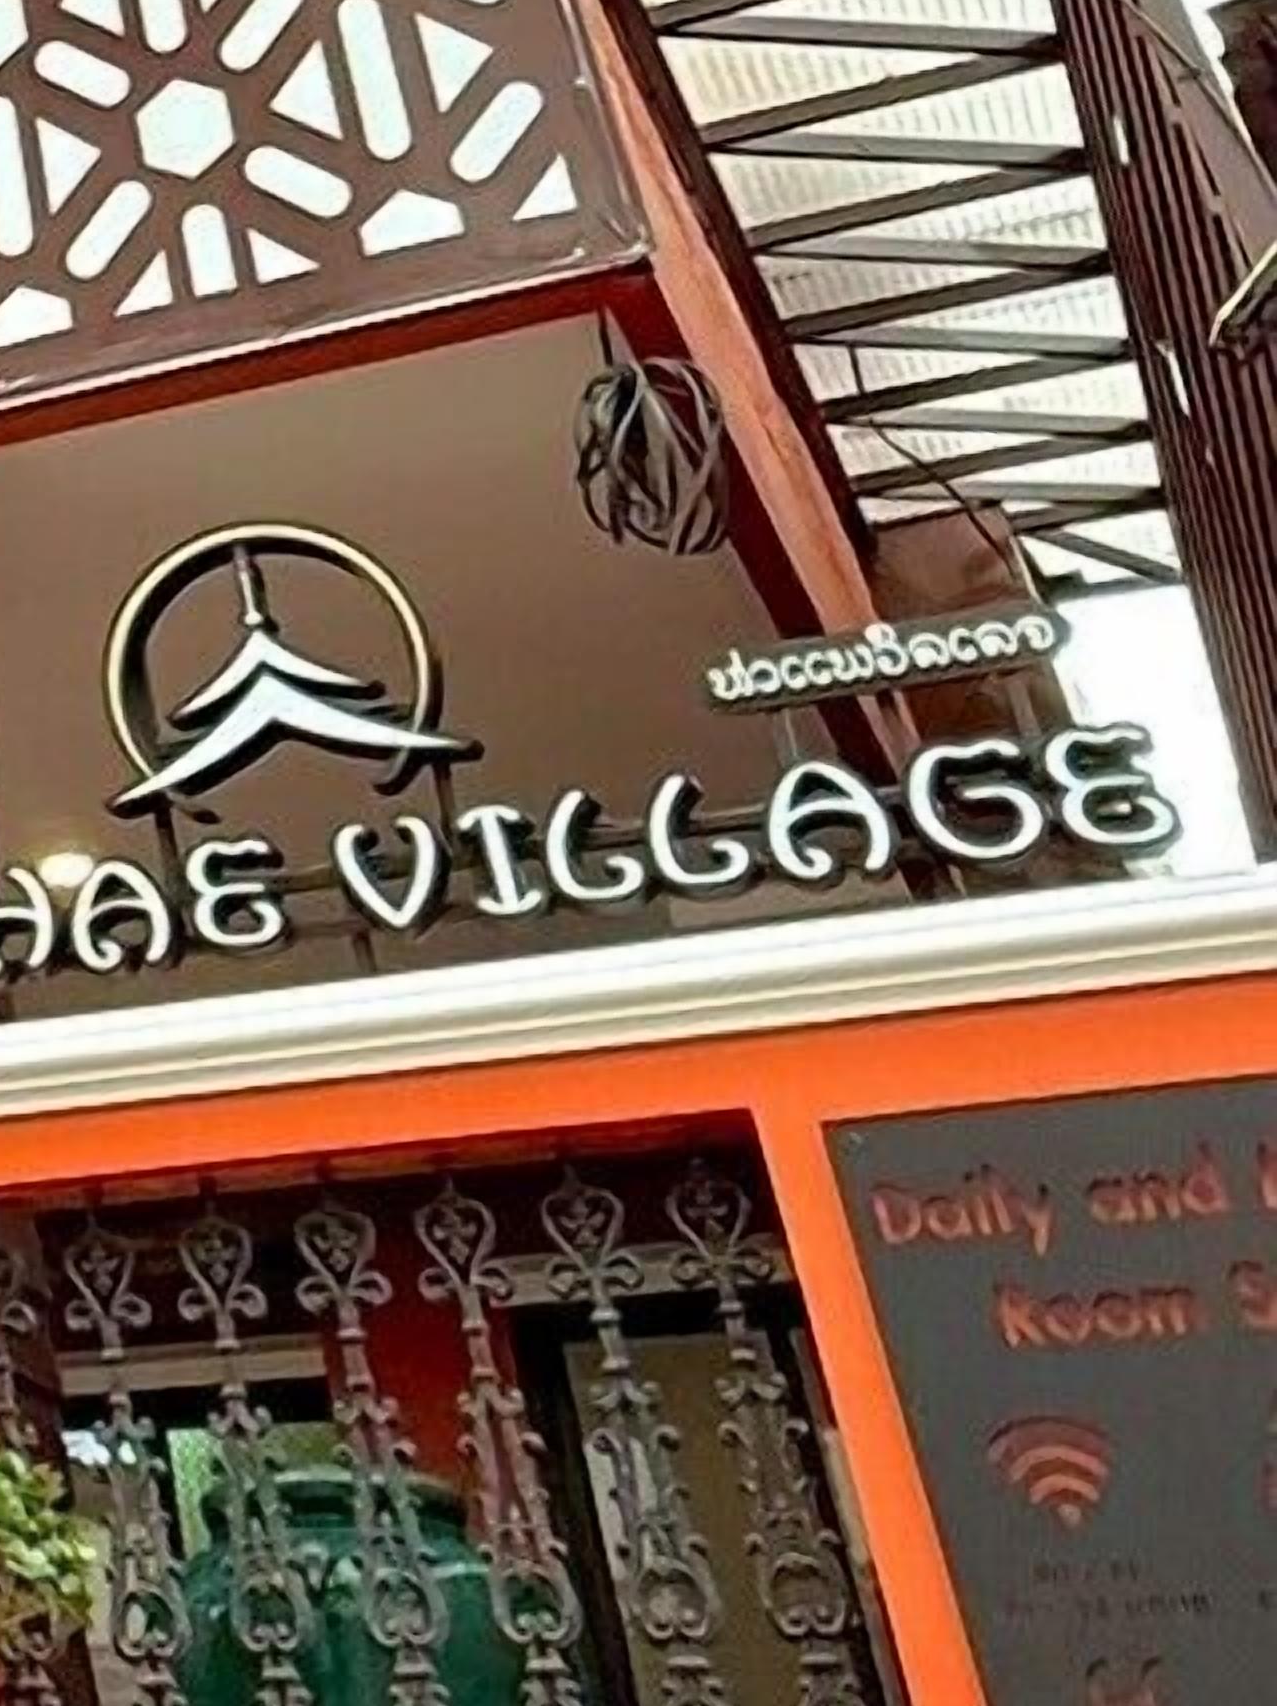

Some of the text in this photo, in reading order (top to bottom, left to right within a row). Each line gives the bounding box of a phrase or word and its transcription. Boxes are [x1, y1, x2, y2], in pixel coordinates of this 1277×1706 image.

[332, 725, 1176, 929] VILLAGE
[872, 1162, 1056, 1257] Daily
[1085, 1139, 1229, 1225] and
[992, 1278, 1212, 1350] Room
